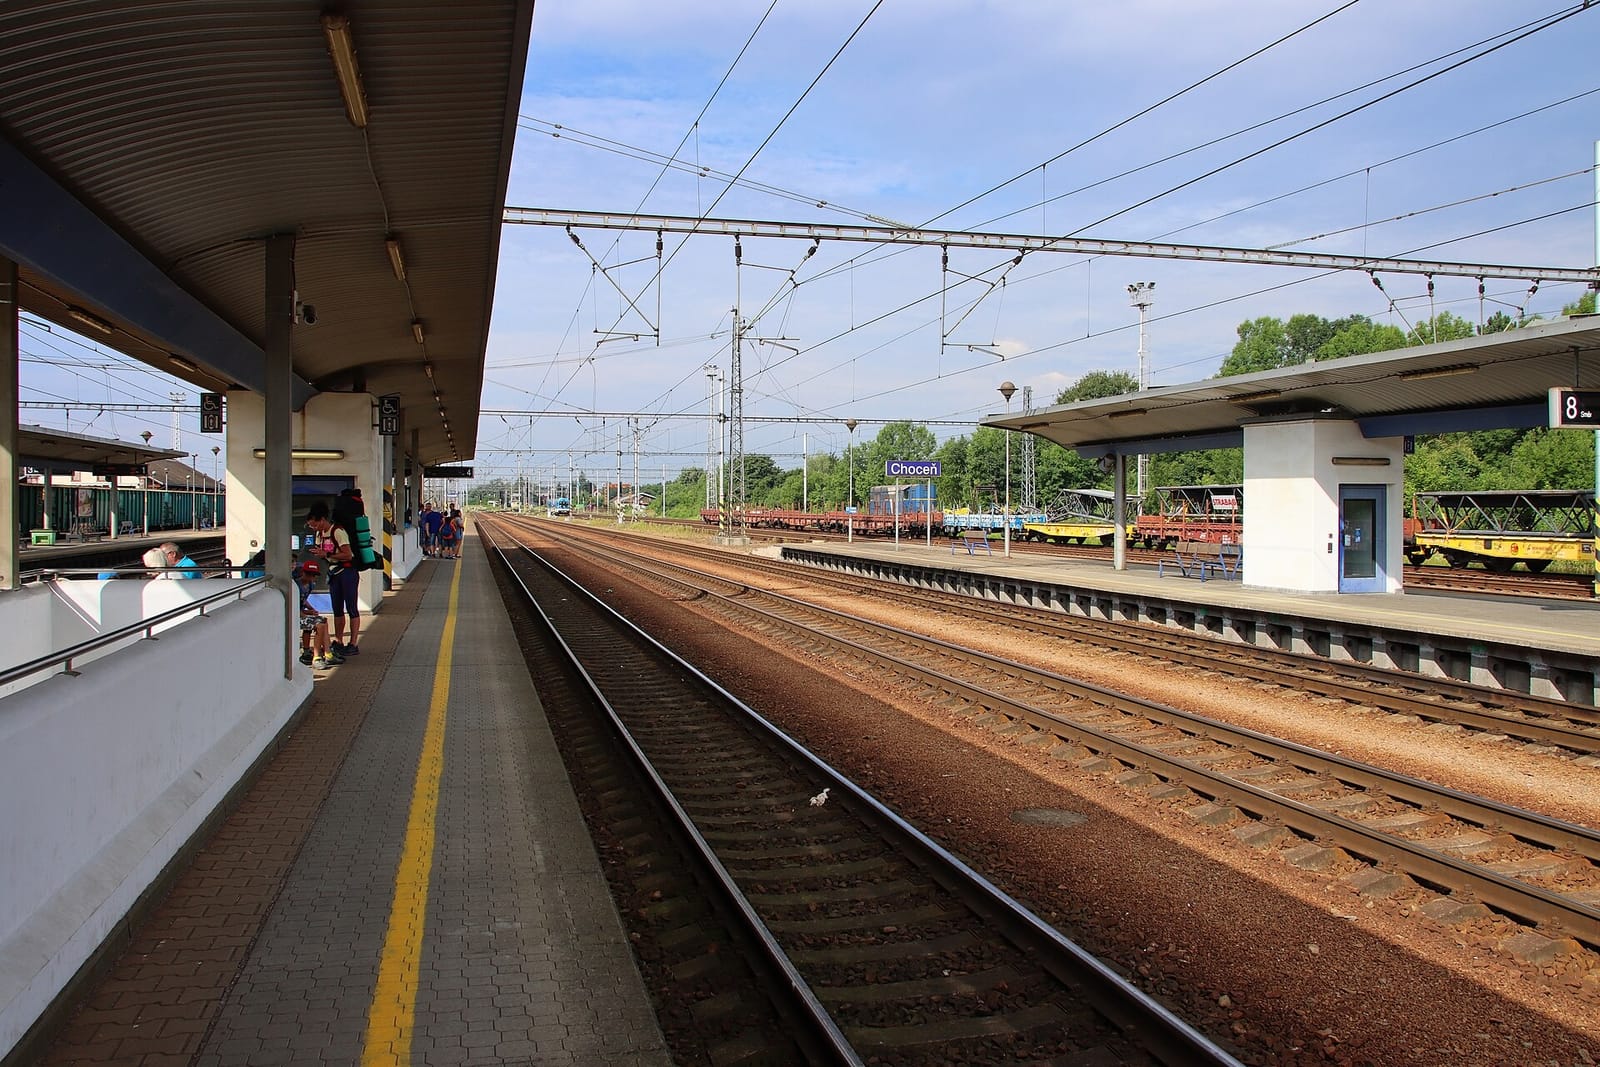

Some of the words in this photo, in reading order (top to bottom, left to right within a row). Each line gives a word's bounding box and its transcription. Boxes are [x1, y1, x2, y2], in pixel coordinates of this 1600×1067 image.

[1566, 396, 1577, 419] 8
[466, 468, 472, 477] 4
[891, 462, 937, 475] Choceň
